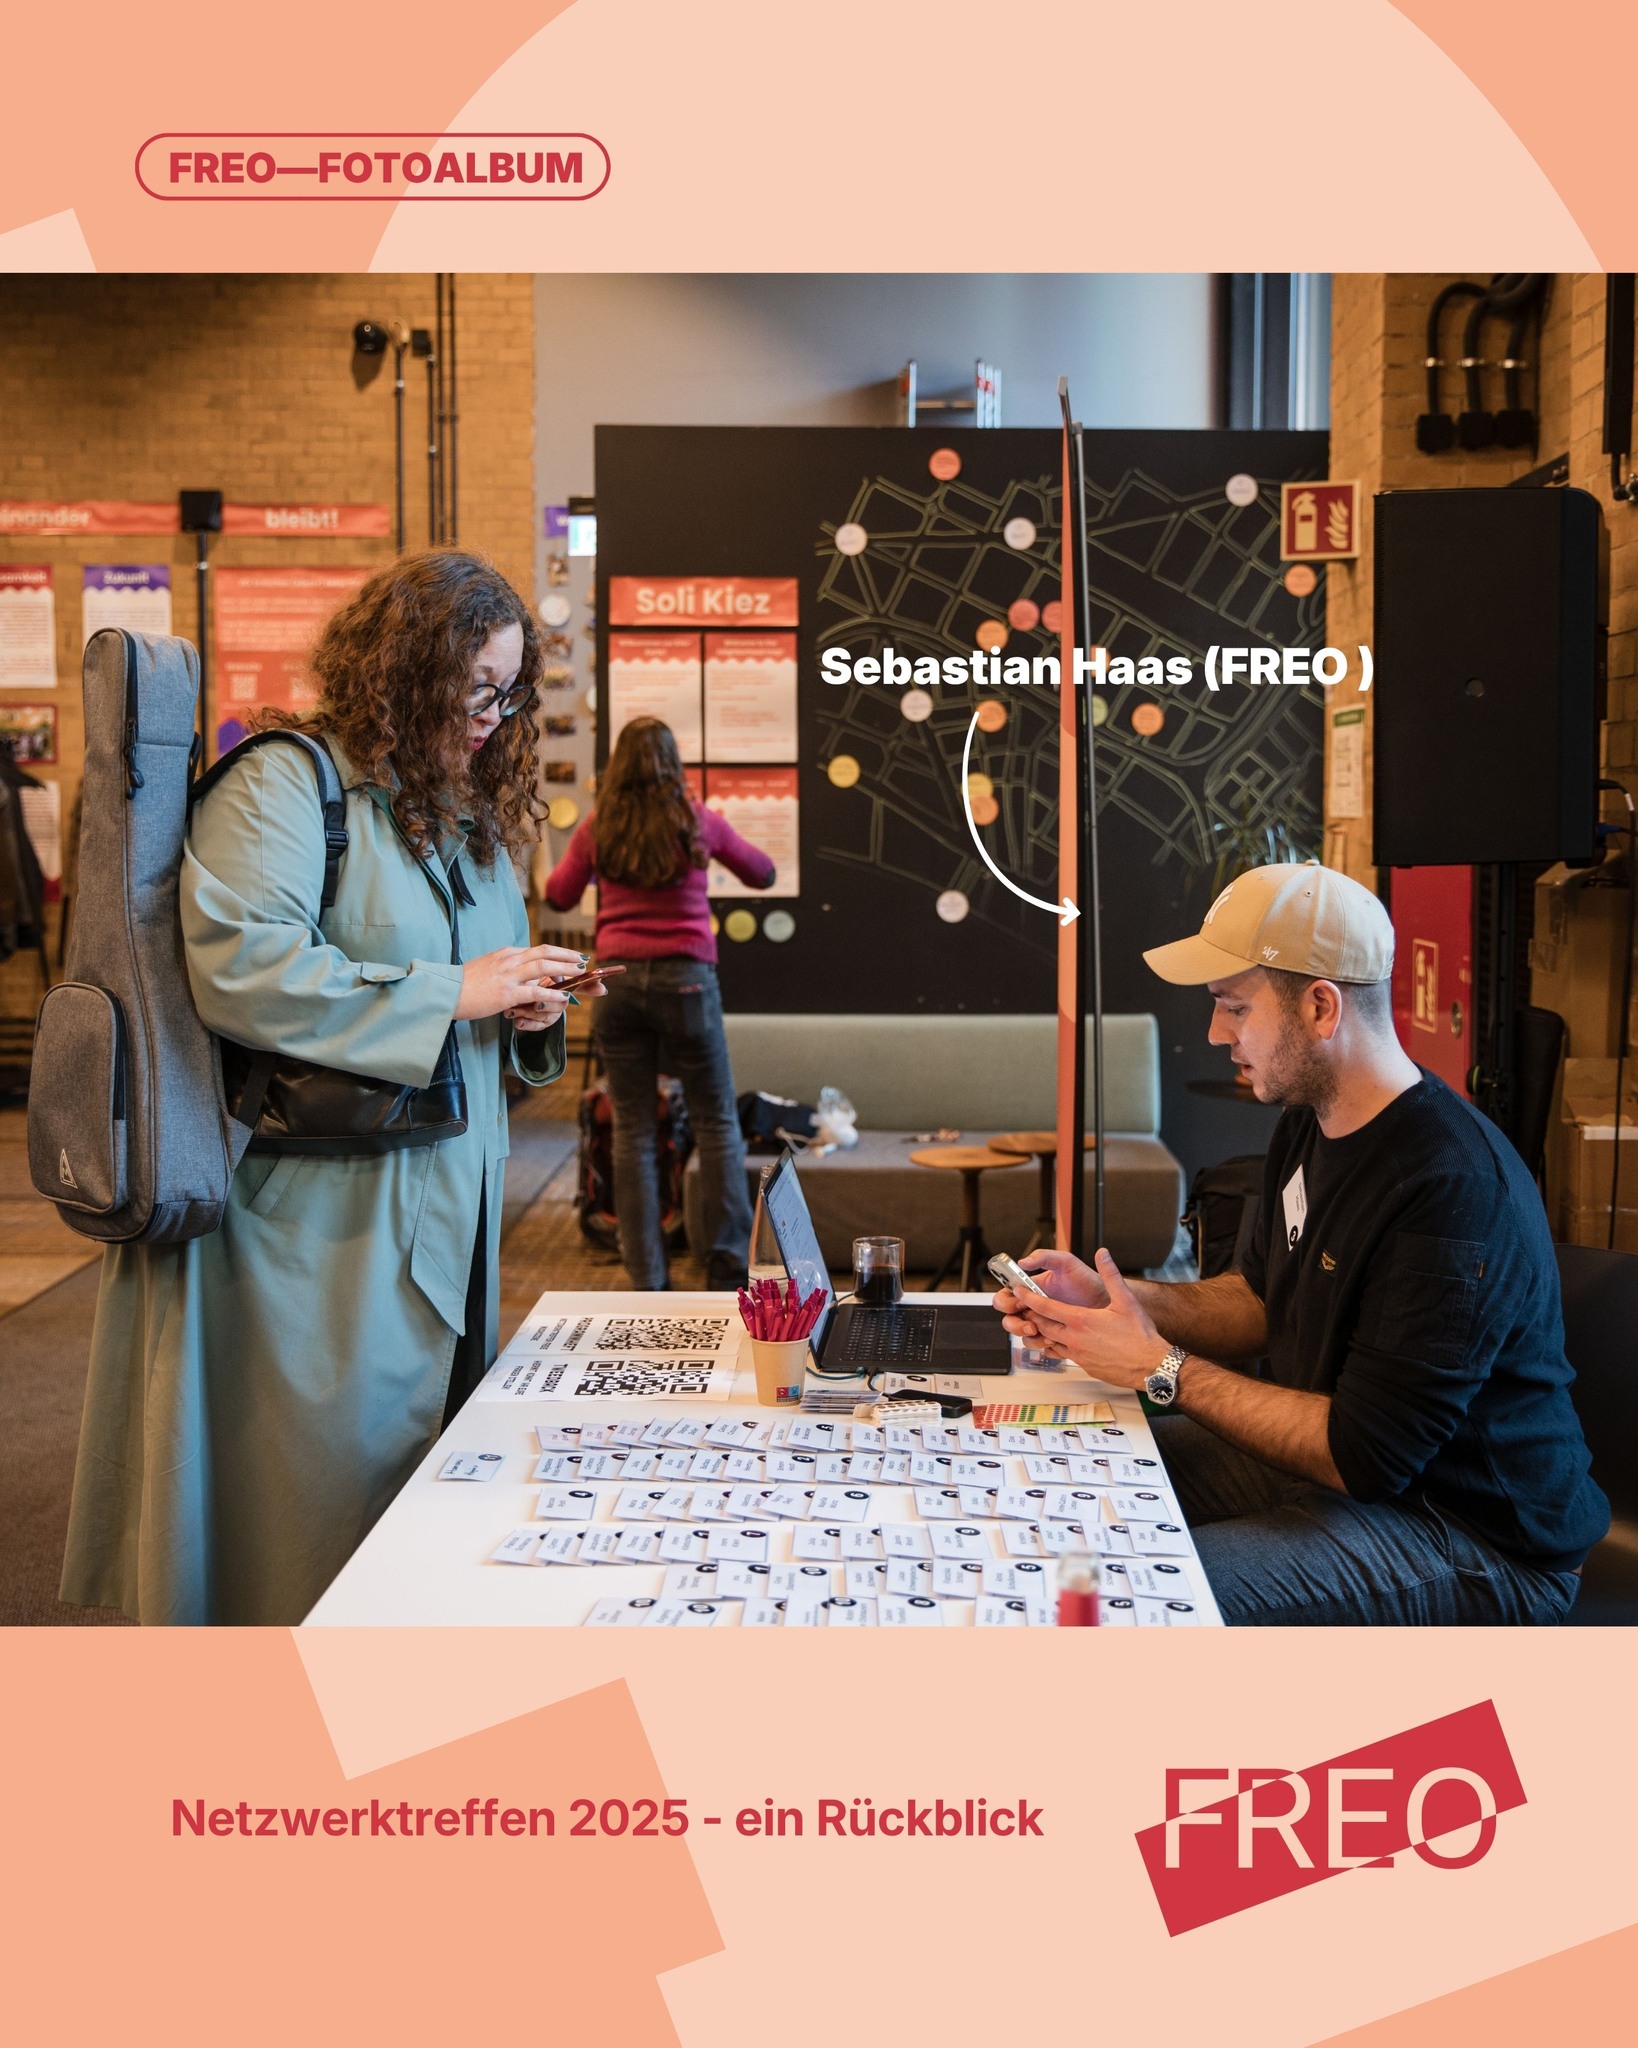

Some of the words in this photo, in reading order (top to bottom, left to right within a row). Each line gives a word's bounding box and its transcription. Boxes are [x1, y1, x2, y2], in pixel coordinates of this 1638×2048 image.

[265, 508, 339, 529] bleibt!
[103, 571, 149, 585] Zukunft
[636, 585, 696, 615] Soli
[702, 585, 771, 615] Kiez
[539, 1364, 569, 1393] TWEEDBACK
